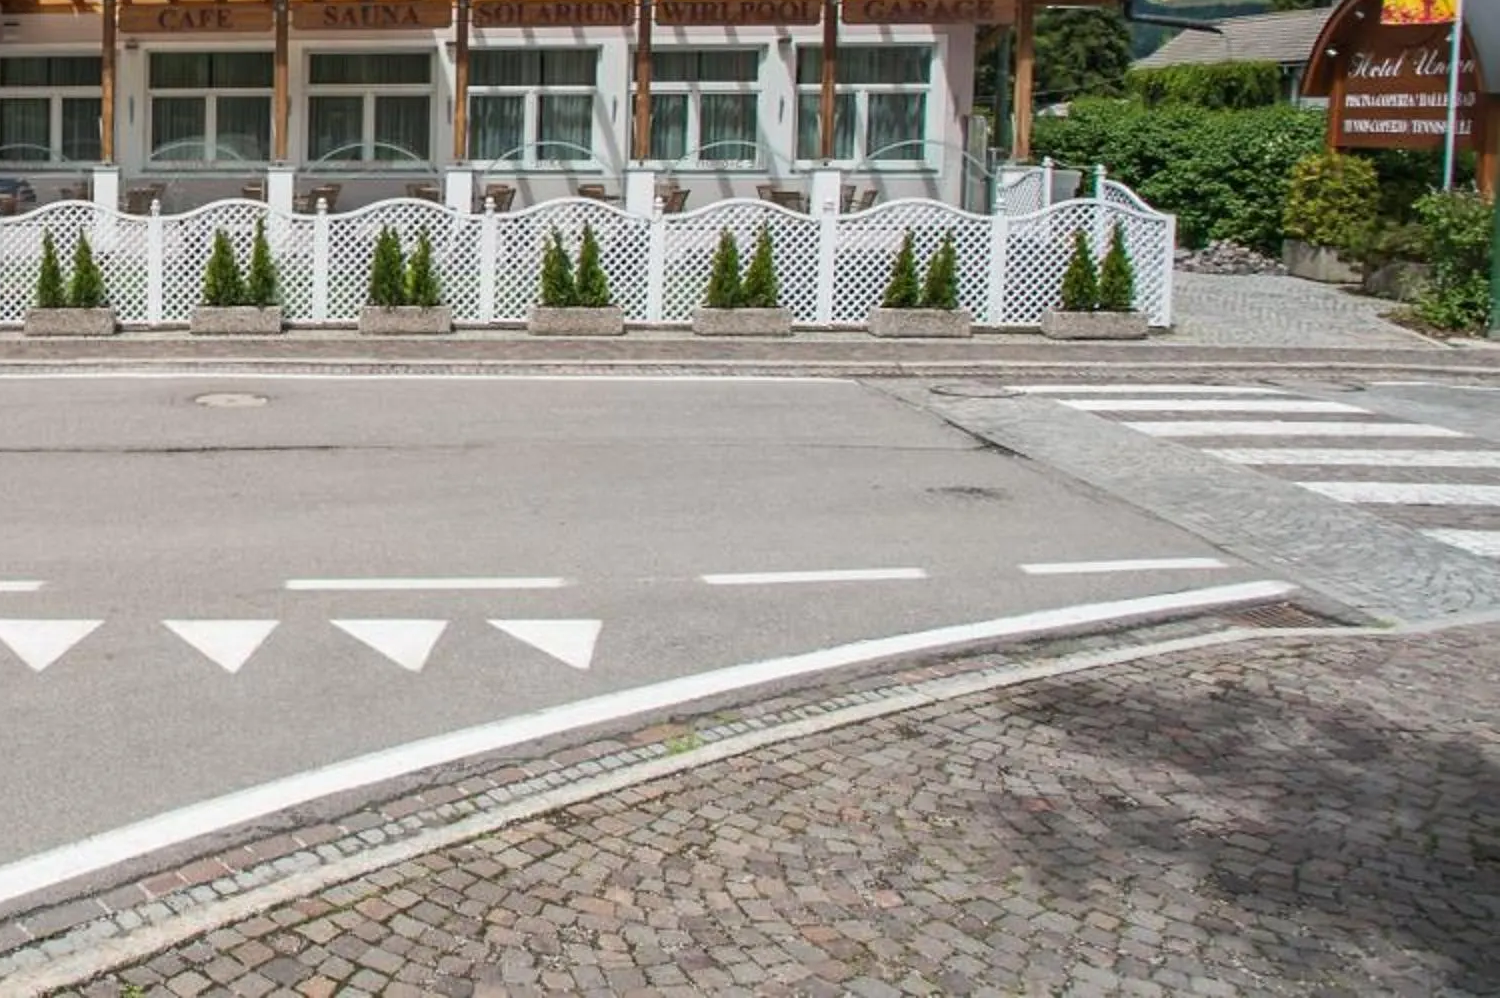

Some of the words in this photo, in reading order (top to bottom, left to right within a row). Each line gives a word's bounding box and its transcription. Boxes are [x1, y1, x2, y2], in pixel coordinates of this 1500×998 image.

[157, 7, 235, 29] CAFE
[323, 5, 420, 26] SAUNA
[475, 1, 631, 24] SOLARIUM
[658, 0, 819, 23] WIRLPOOL
[863, 0, 995, 21] GARAGE
[1348, 49, 1408, 79] Hotel
[1413, 46, 1475, 76] Unn
